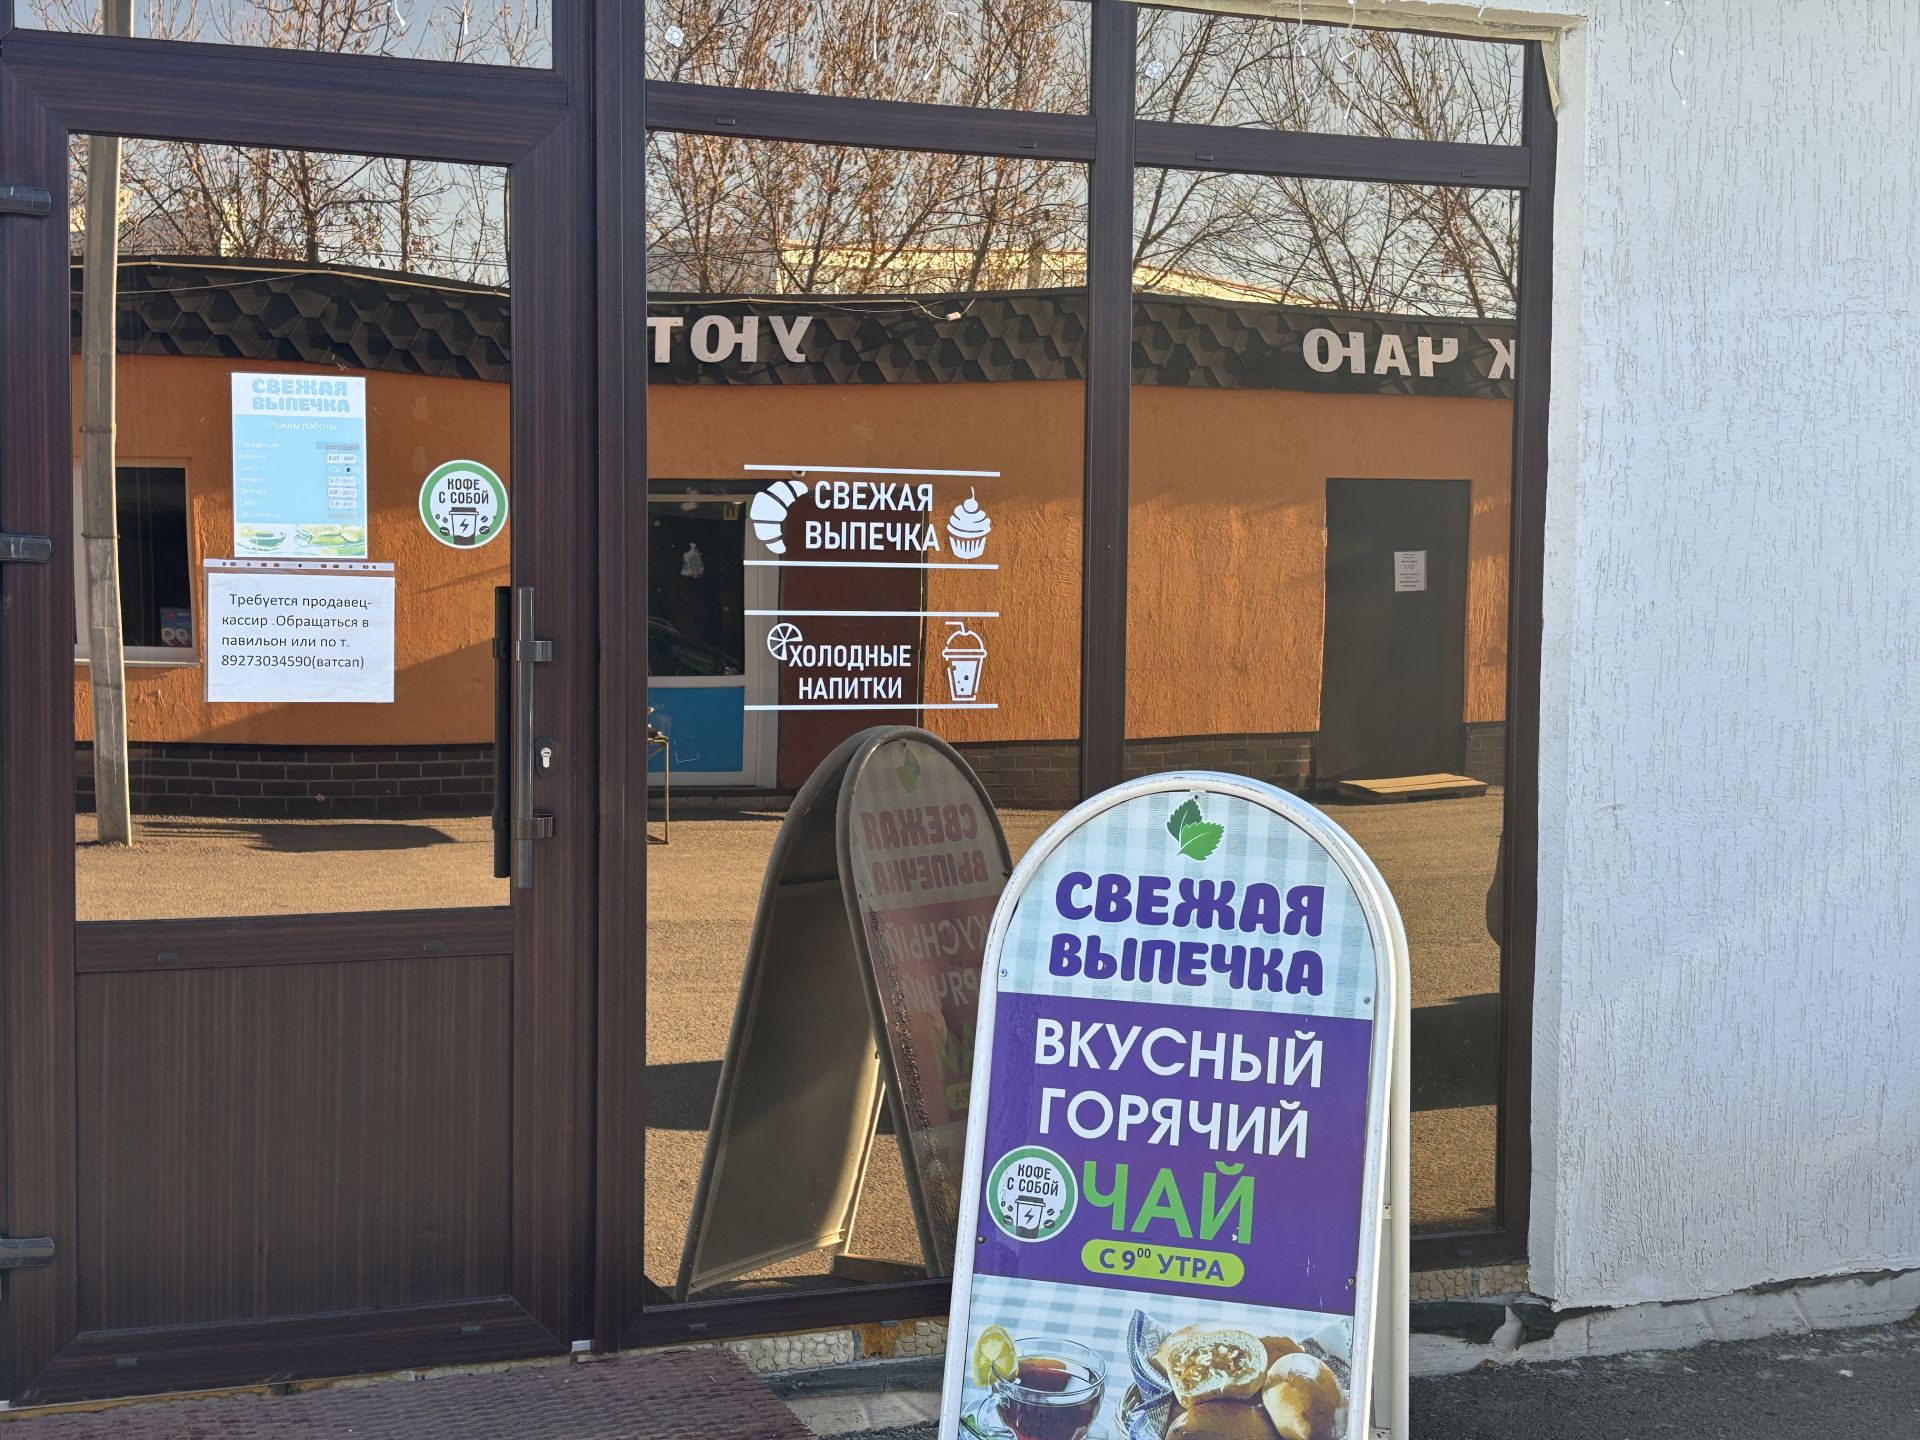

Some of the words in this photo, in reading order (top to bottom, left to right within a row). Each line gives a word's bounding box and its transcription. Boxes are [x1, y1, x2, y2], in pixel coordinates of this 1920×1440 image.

[251, 378, 348, 397] СВЕЖАЯ
[252, 396, 350, 413] ВЫПЕЧКА
[302, 421, 337, 432] работы
[447, 478, 480, 491] КОФЕ
[438, 491, 446, 504] С
[450, 490, 489, 504] СОБОЙ
[814, 480, 933, 512] СВЕЖАЯ
[805, 520, 941, 552] ВЫПЕЧКА
[229, 593, 298, 608] Требуется
[302, 597, 373, 610] продавец-
[222, 615, 268, 628] кассир
[362, 618, 369, 628] в
[221, 636, 287, 647] павильон
[291, 637, 316, 647] или
[320, 638, 337, 648] по
[340, 638, 350, 648] т.
[221, 654, 365, 670] 89273034590(ватсап)
[788, 644, 912, 672] ХОЛОДНЫЕ
[798, 677, 903, 700] НАПИТКИ
[1055, 871, 1325, 937] СВЕЖАЯ
[1048, 933, 1324, 997] ВЫПЕЧКА
[1034, 1017, 1324, 1088] ВКУСНЫЙ
[1039, 1087, 1308, 1159] ГОРЯЧИЙ
[1017, 1163, 1052, 1181] КОФЕ
[1006, 1177, 1015, 1190] С
[1018, 1178, 1059, 1197] СОБОЙ
[1082, 1160, 1255, 1245] ЧАЙ
[1099, 1247, 1115, 1269] С
[1156, 1253, 1225, 1281] УТРА
